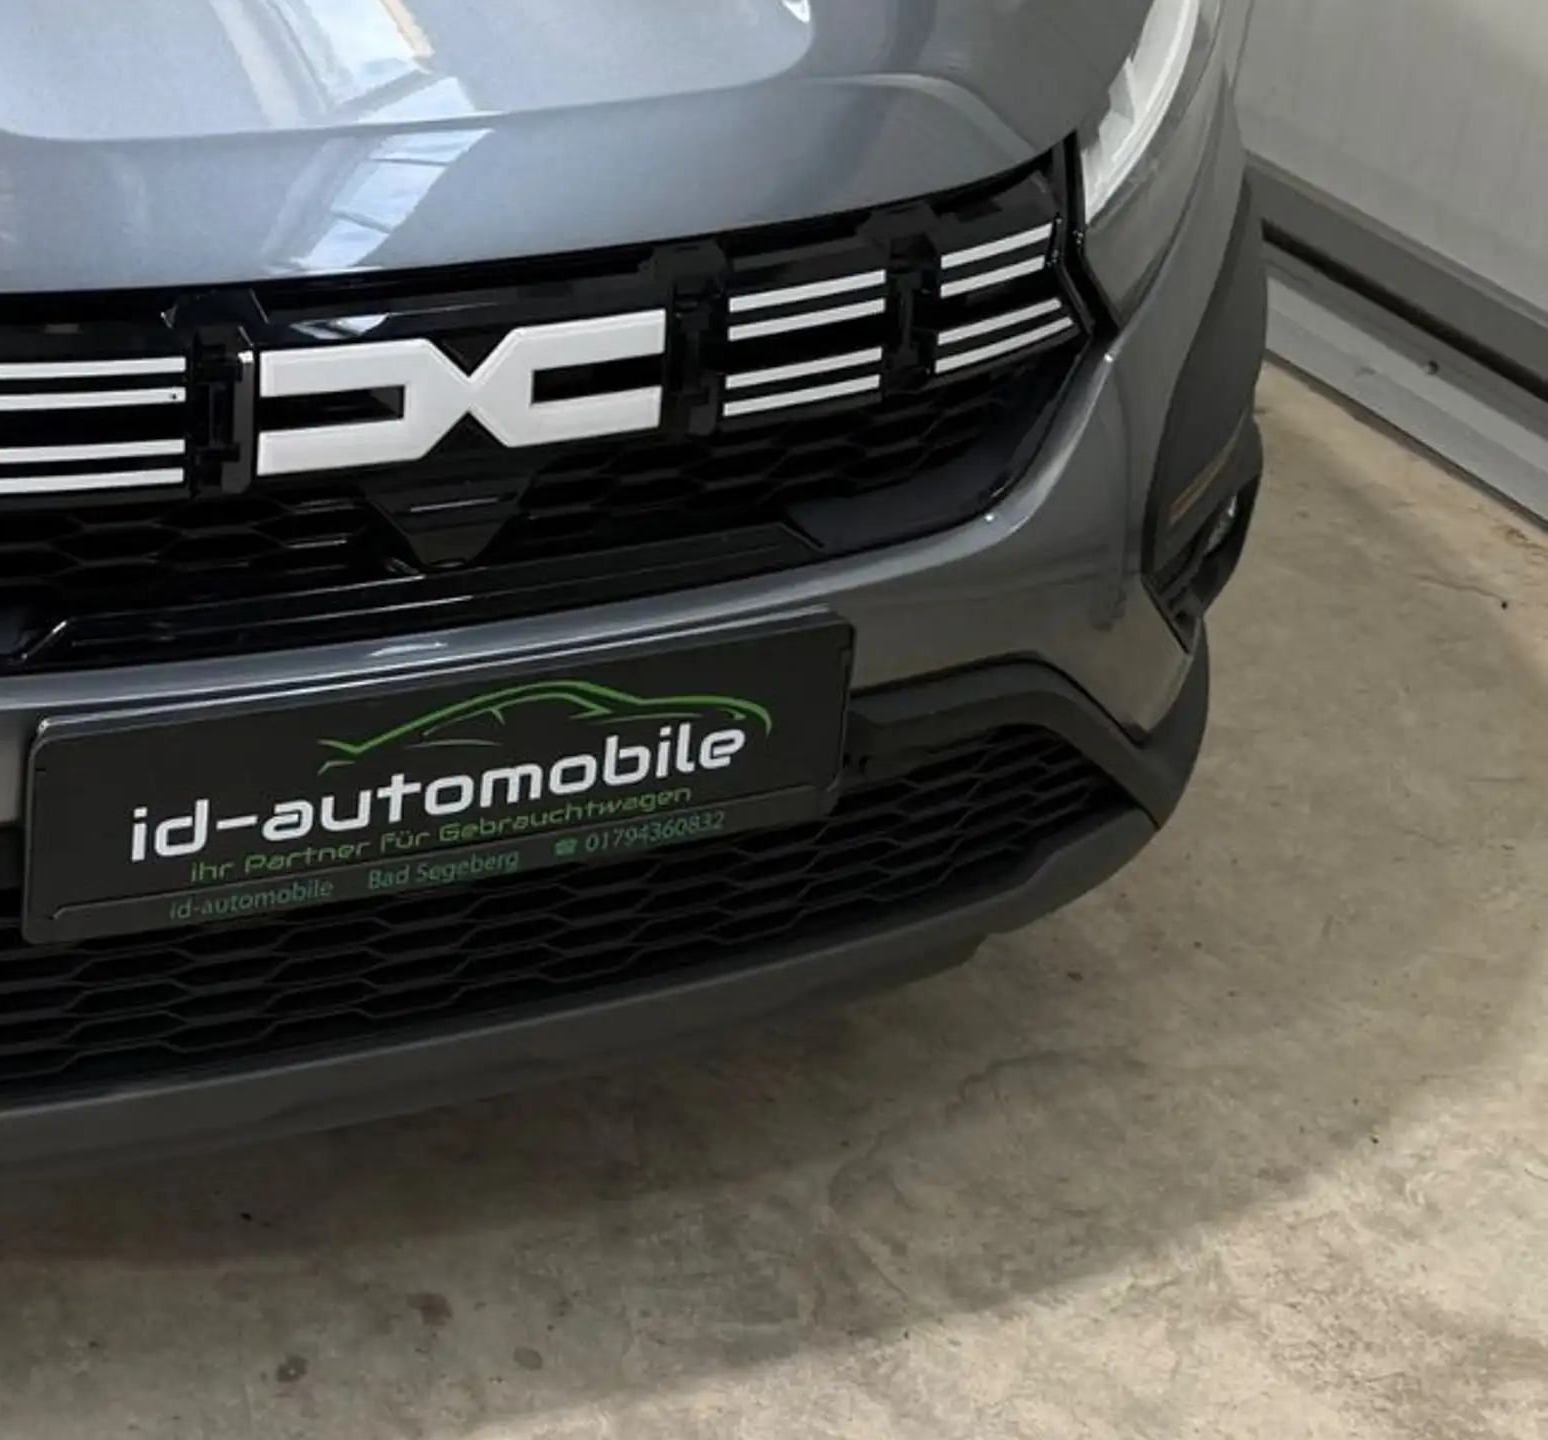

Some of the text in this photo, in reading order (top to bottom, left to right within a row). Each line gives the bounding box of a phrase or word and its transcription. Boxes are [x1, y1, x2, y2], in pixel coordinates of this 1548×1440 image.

[131, 722, 746, 861] id-automobile
[190, 861, 235, 883] Ihr
[244, 841, 371, 875] Partner
[439, 786, 692, 843] Gebrauchtwagen
[367, 863, 410, 890] Bad
[416, 849, 520, 885] Segeberg
[585, 810, 726, 853] 01794360832
